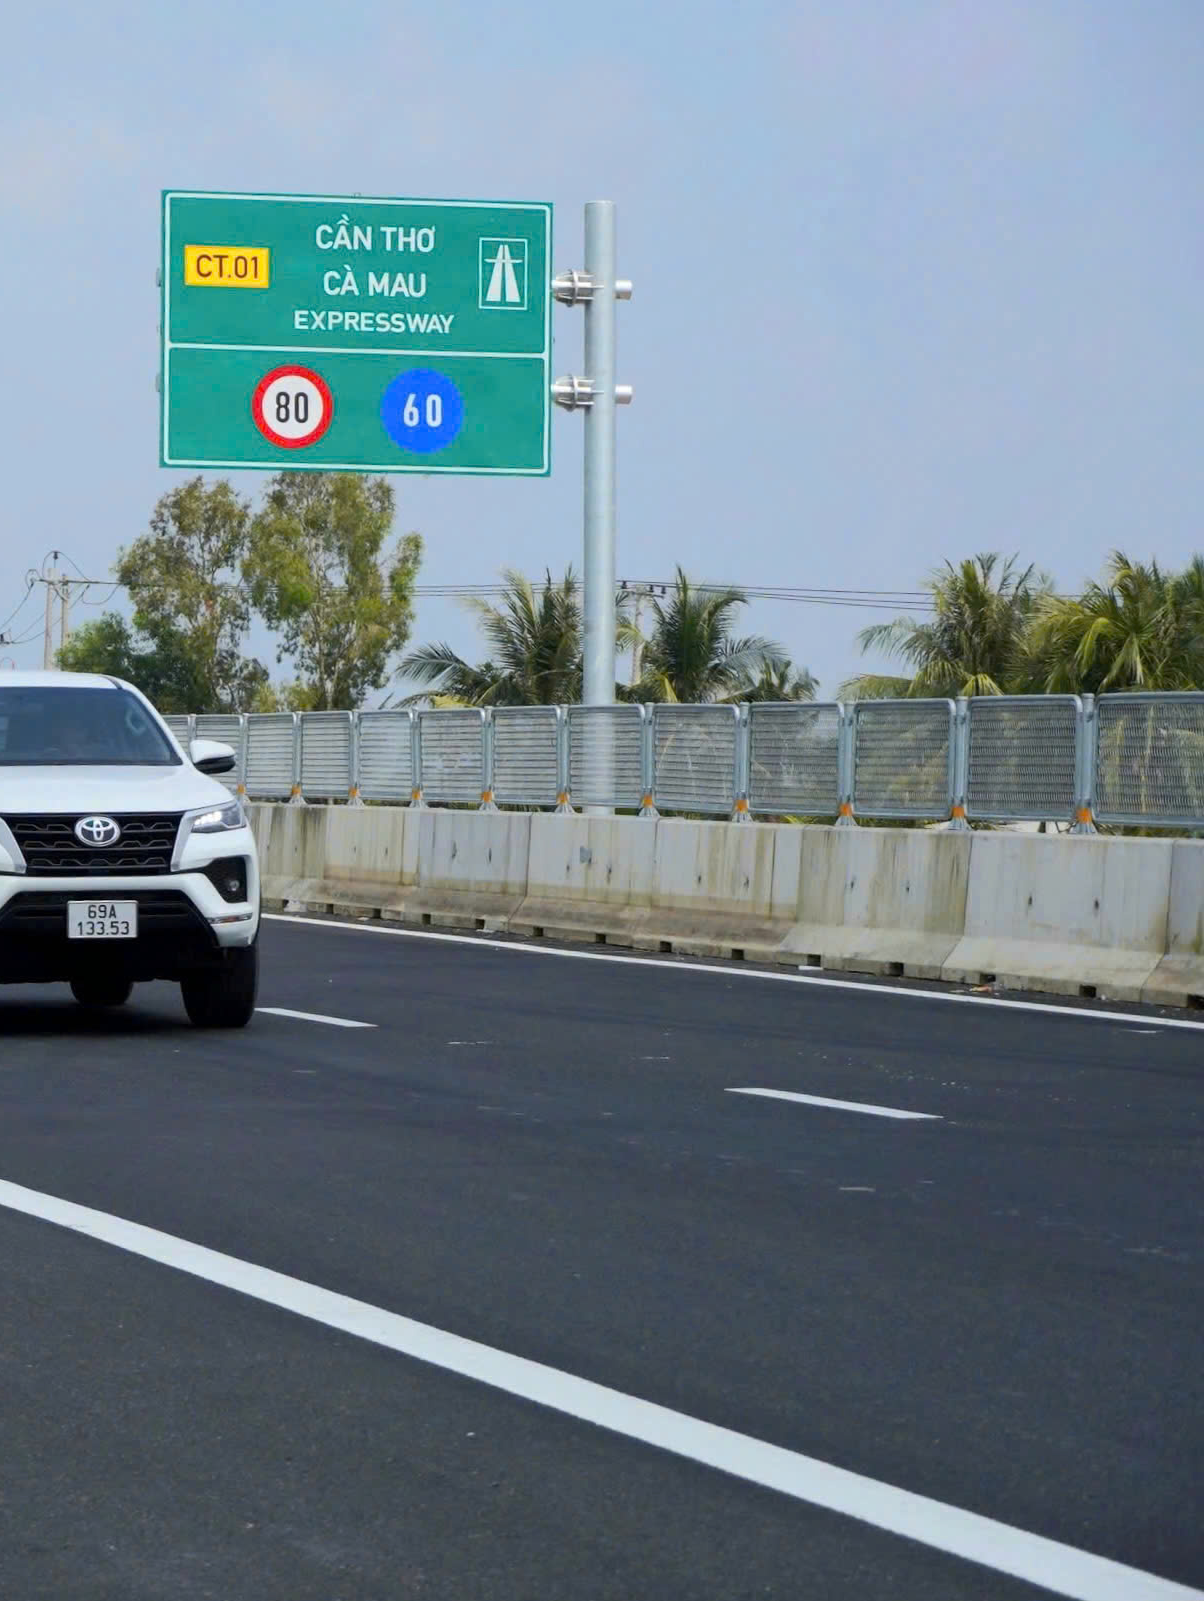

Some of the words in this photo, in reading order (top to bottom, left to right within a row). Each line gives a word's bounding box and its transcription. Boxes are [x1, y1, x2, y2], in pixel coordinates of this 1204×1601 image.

[315, 213, 373, 251] CẦN
[379, 225, 436, 253] THƠ
[196, 254, 259, 279] CT.01
[323, 264, 360, 296] CÀ
[368, 271, 427, 298] MAU
[294, 309, 455, 334] EXPRESSWAY
[275, 391, 309, 424] 80
[403, 393, 443, 428] 60
[88, 904, 117, 919] 69A
[77, 920, 130, 936] 133.53
